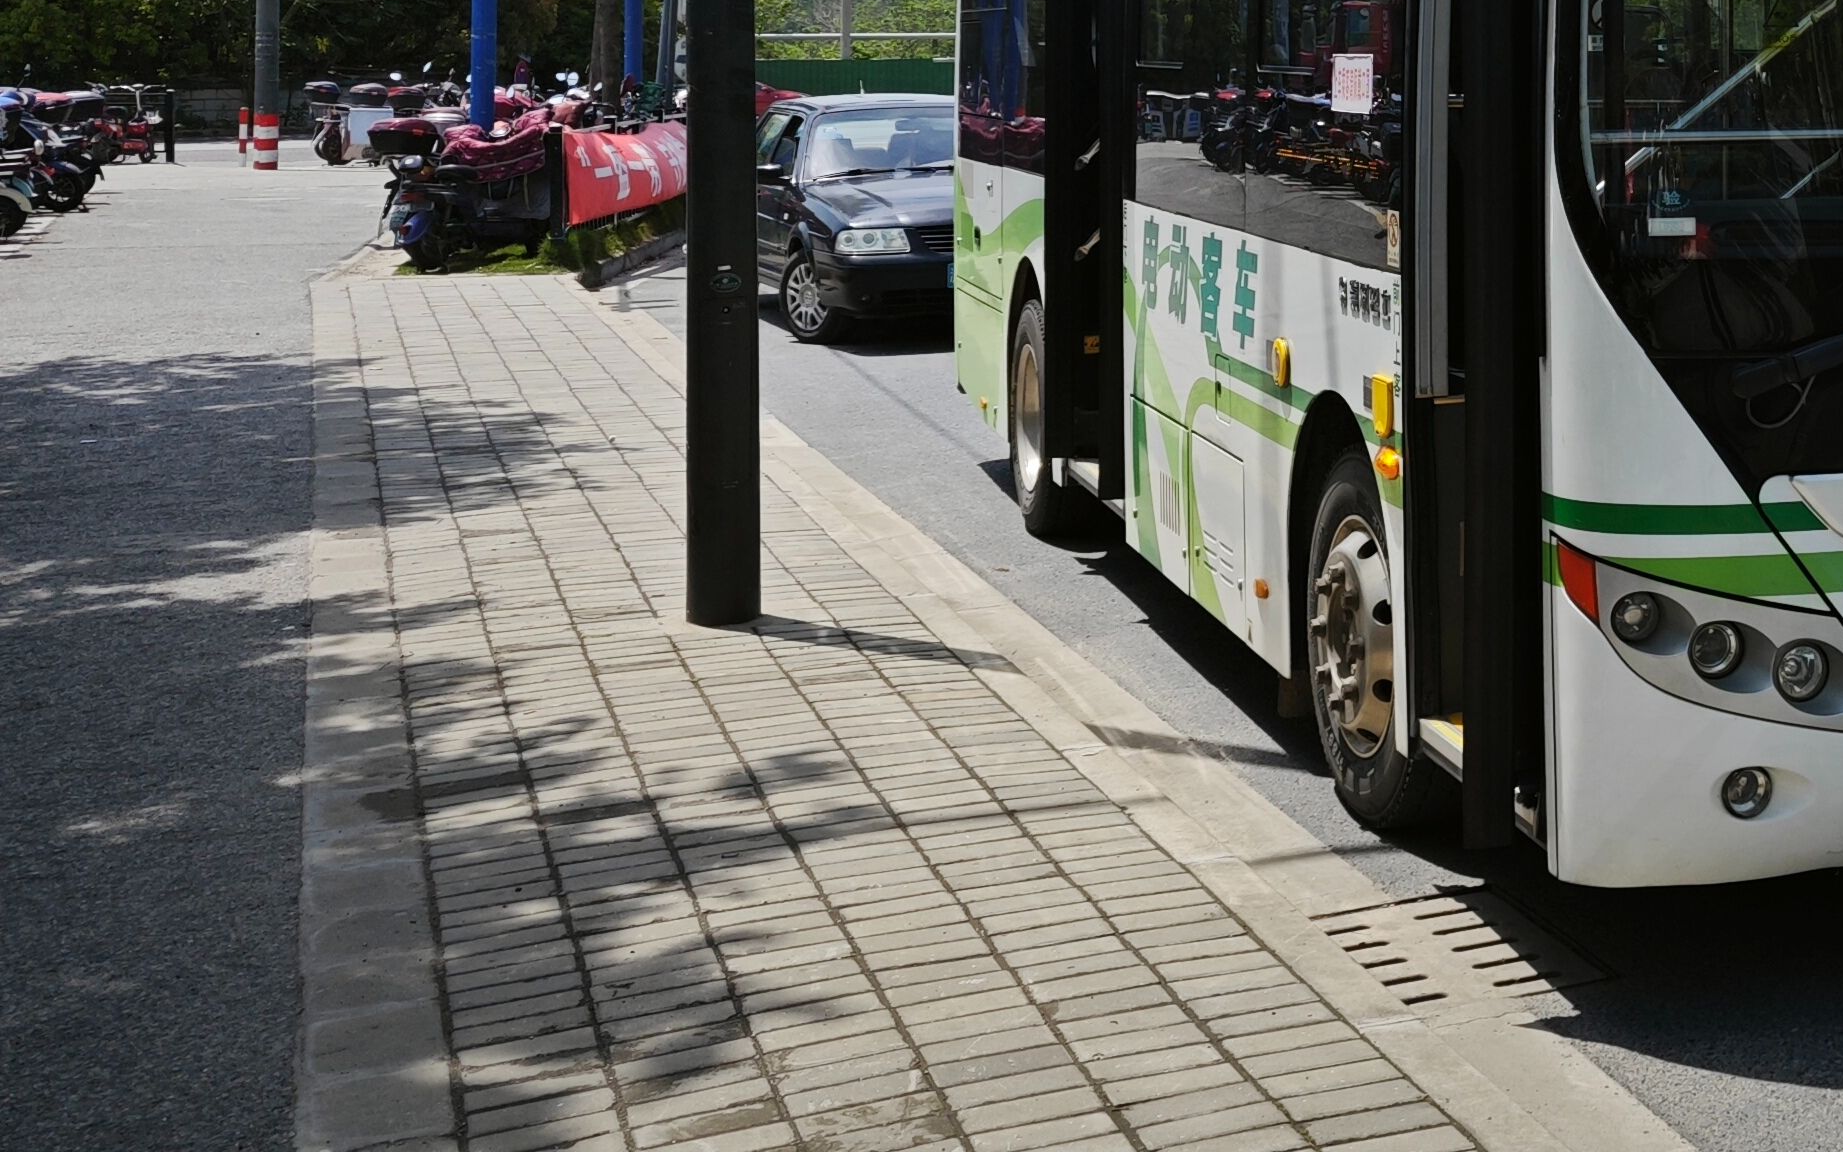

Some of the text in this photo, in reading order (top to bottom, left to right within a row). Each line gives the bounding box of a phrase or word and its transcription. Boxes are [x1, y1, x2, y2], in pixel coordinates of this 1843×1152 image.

[1662, 191, 1681, 206] 验
[1141, 214, 1259, 350] 电动客车
